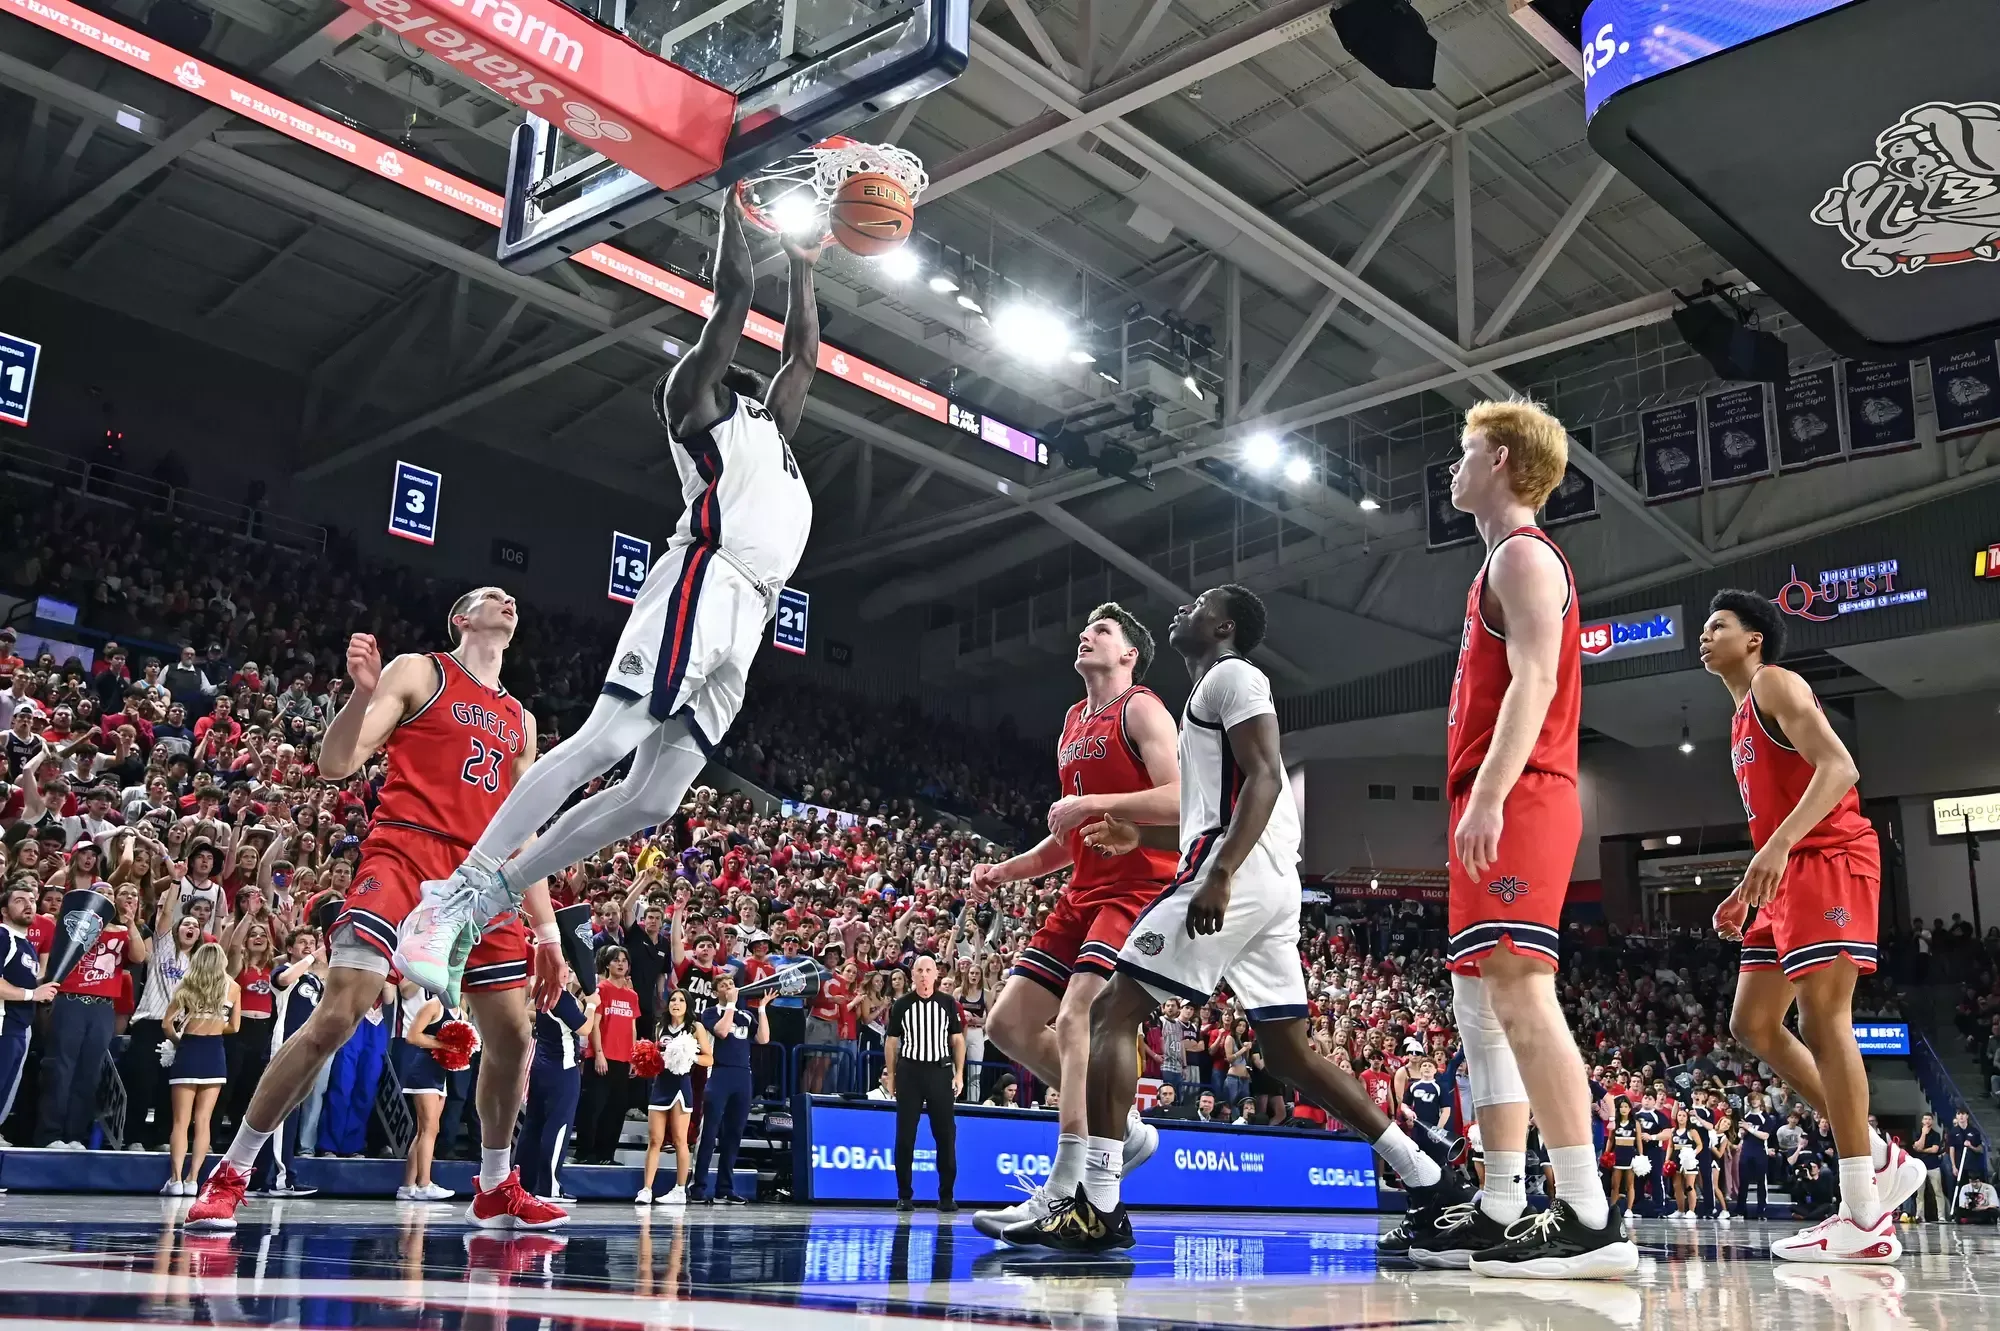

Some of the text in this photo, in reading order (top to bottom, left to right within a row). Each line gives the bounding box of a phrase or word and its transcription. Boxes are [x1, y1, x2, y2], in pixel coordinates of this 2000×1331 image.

[27, 1, 69, 26] HAVE
[71, 18, 100, 40] THE
[100, 31, 150, 62] MEATS
[230, 89, 356, 153] WE HAVE THE MEATS
[424, 176, 443, 192] WE
[444, 184, 474, 206] HAVE
[475, 199, 497, 217] THE
[591, 250, 686, 299] WE HAVE THE MEATS
[1937, 355, 1991, 375] First Round
[1950, 350, 1976, 362] NCAA
[0, 360, 26, 393] 1
[1848, 377, 1909, 394] Sweet Sixteen
[1865, 372, 1891, 382] NCAA
[1784, 379, 1824, 393] BASKETBALL
[1793, 389, 1817, 399] NCAA
[1716, 396, 1753, 408] BASKETBALL
[1724, 406, 1747, 416] NCAA
[1786, 395, 1827, 411] Elite Eight
[1652, 414, 1687, 425] BASKETBALL
[1659, 423, 1682, 434] NCAA
[1709, 411, 1762, 429] Sweet Sixteen
[405, 489, 426, 514] 3
[501, 547, 524, 564] 106
[615, 555, 645, 582] 13
[1819, 559, 1898, 584] NORTHERN
[1768, 564, 1898, 622] QUEST
[1838, 589, 1927, 614] RESORT & CASINO
[779, 606, 804, 632] 21
[1580, 615, 1672, 648] us bank
[452, 702, 519, 753] GAELS
[1059, 736, 1108, 770] GAELS
[461, 736, 504, 793] 23
[1938, 803, 1983, 821] indigo
[1334, 886, 1363, 896] BAKED
[1366, 888, 1398, 897] POTATO
[1421, 890, 1443, 898] TACO
[84, 970, 110, 982] Club
[694, 998, 707, 1013] 11
[1870, 1028, 1904, 1037] BEST.
[1414, 1089, 1435, 1103] GU
[1175, 1148, 1264, 1172] GLOBAL CREDIT
[1241, 1163, 1264, 1172] UNION
[1308, 1167, 1364, 1187] GLOBAL
